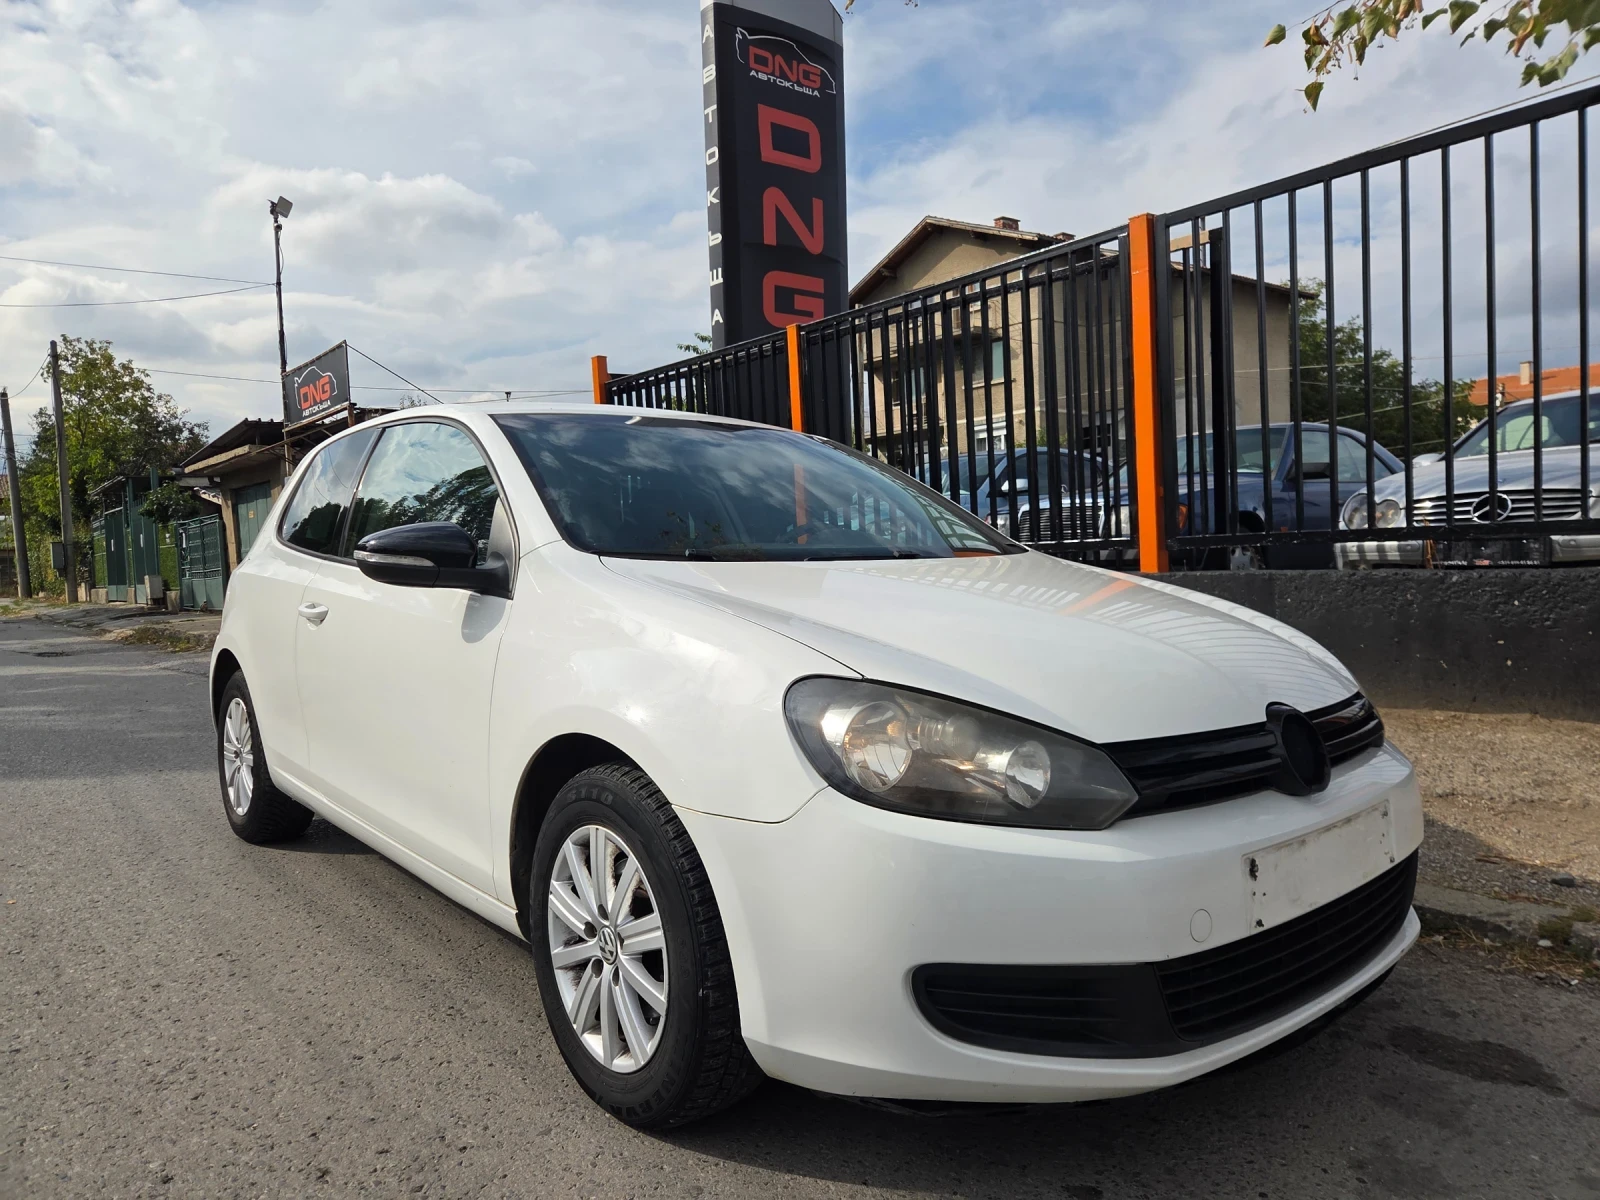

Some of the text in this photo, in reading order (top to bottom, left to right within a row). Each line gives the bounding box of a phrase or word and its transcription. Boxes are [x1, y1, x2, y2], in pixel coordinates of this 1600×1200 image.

[749, 45, 821, 89] DNG
[757, 103, 824, 328] DNG
[300, 375, 330, 410] DNG
